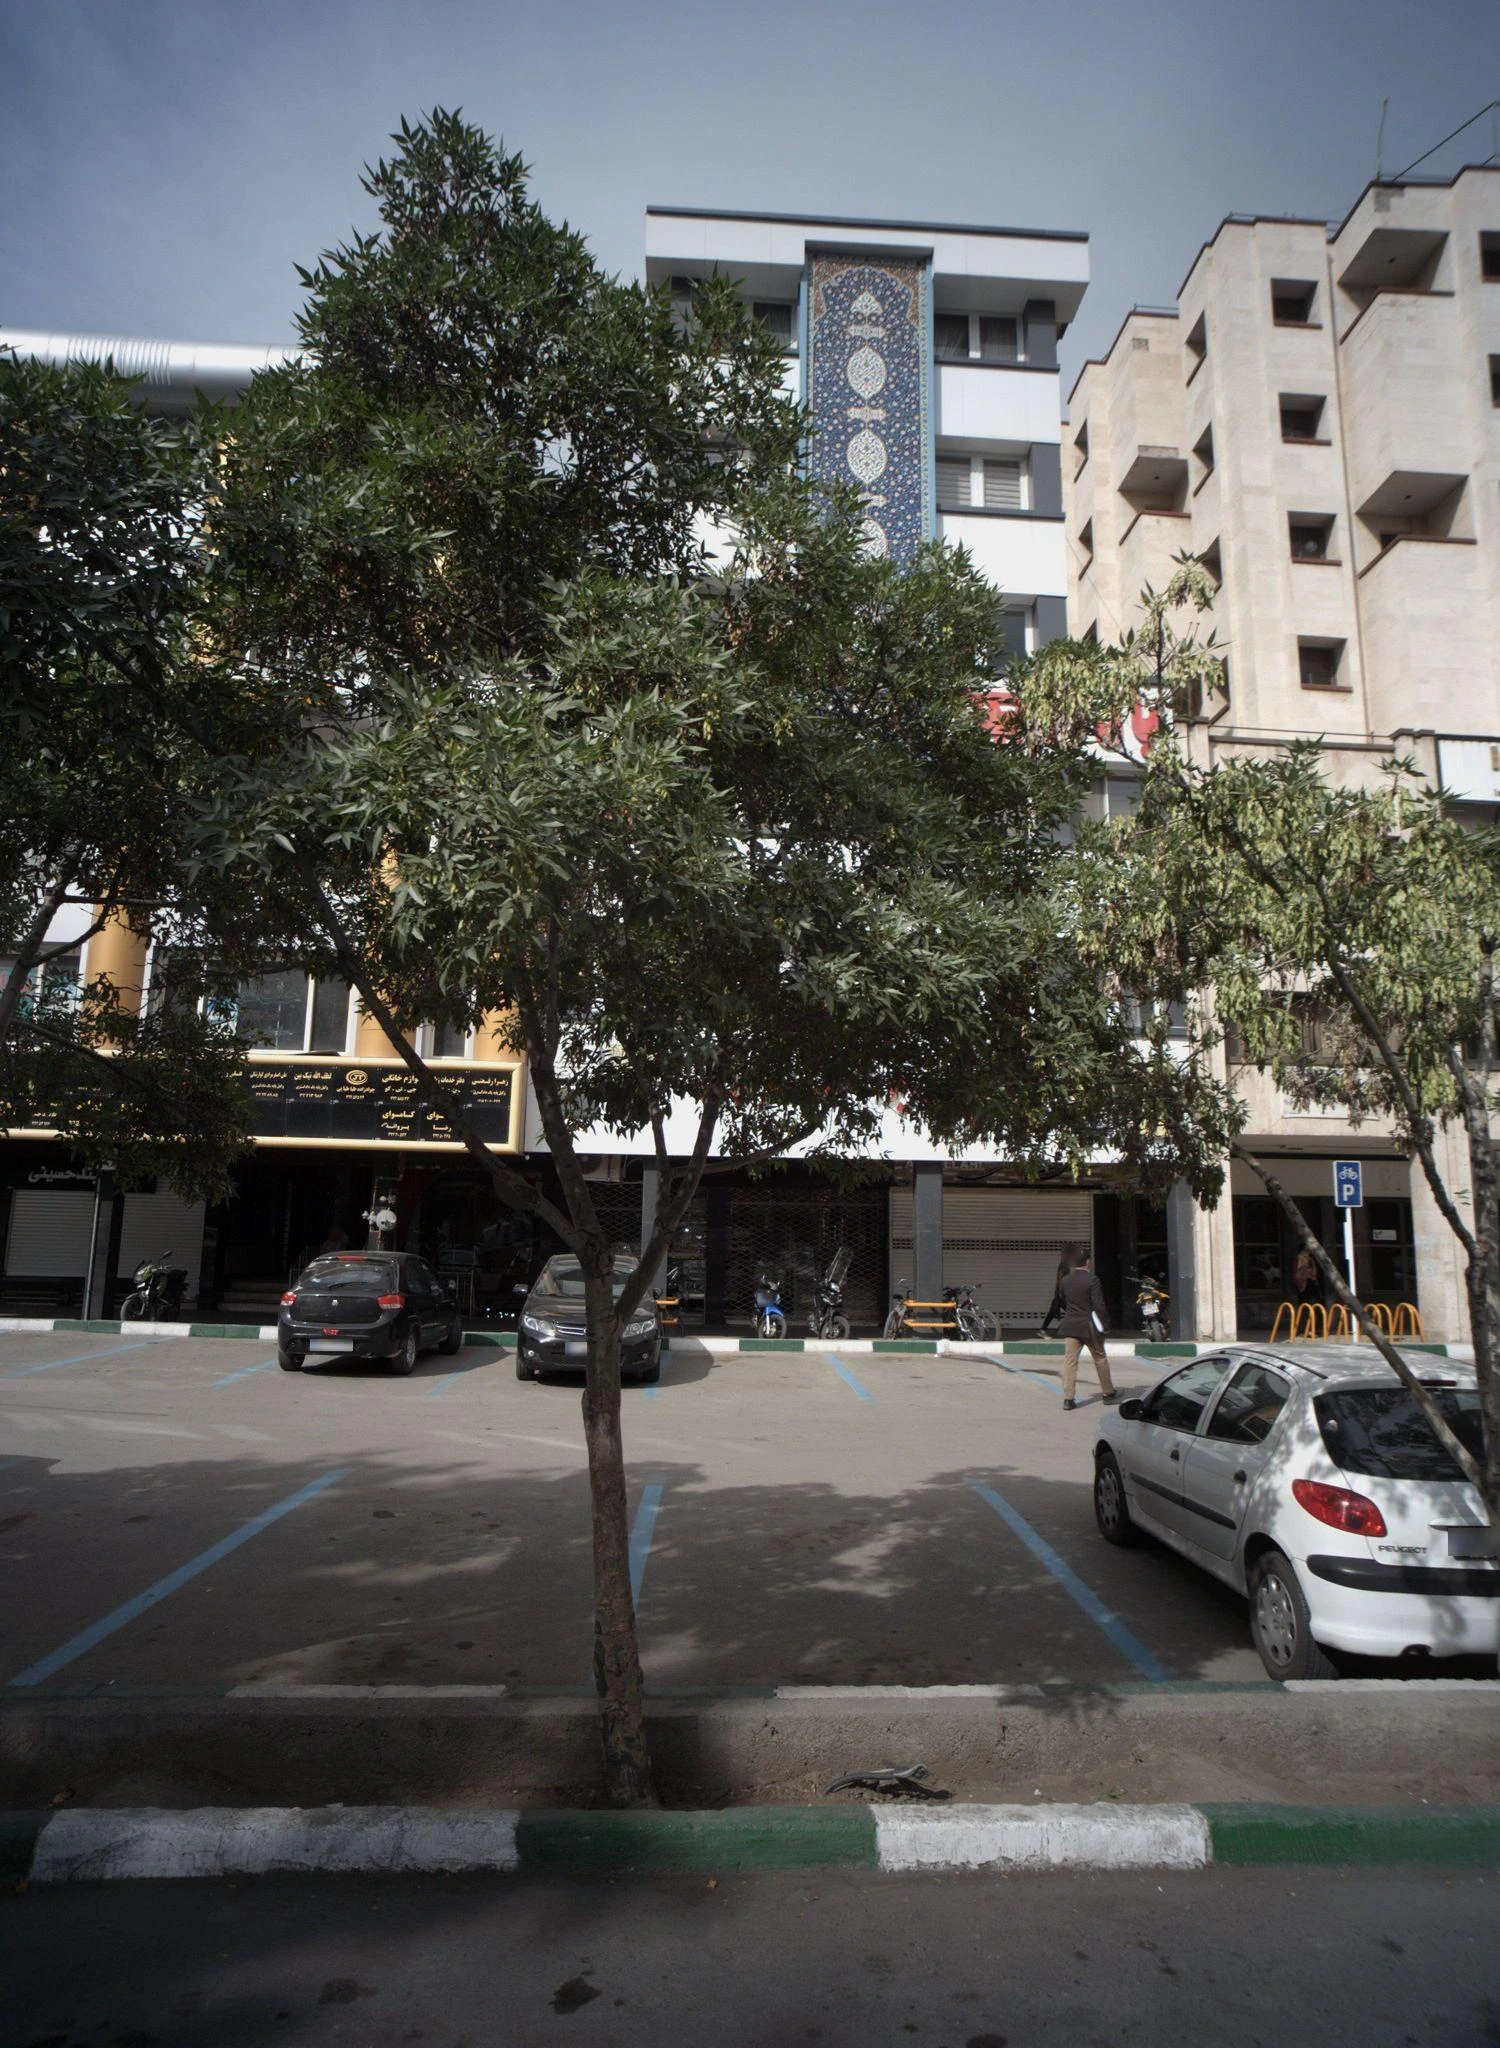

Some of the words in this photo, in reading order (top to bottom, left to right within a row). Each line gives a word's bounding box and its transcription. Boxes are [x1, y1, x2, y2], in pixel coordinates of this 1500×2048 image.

[302, 1071, 312, 1081] نیک
[313, 1071, 321, 1079] الله
[321, 1071, 332, 1079] لطف
[382, 1073, 402, 1083] خانگی
[403, 1074, 420, 1084] وازم
[440, 1074, 455, 1083] خدمات
[455, 1076, 465, 1085] دفتر
[494, 1077, 509, 1086] زهرا
[382, 1109, 416, 1120] کاموای
[432, 1123, 452, 1133] رضا
[27, 1165, 76, 1183] حسینی
[1343, 1184, 1355, 1202] P
[1378, 1545, 1428, 1554] PEUGEOT
